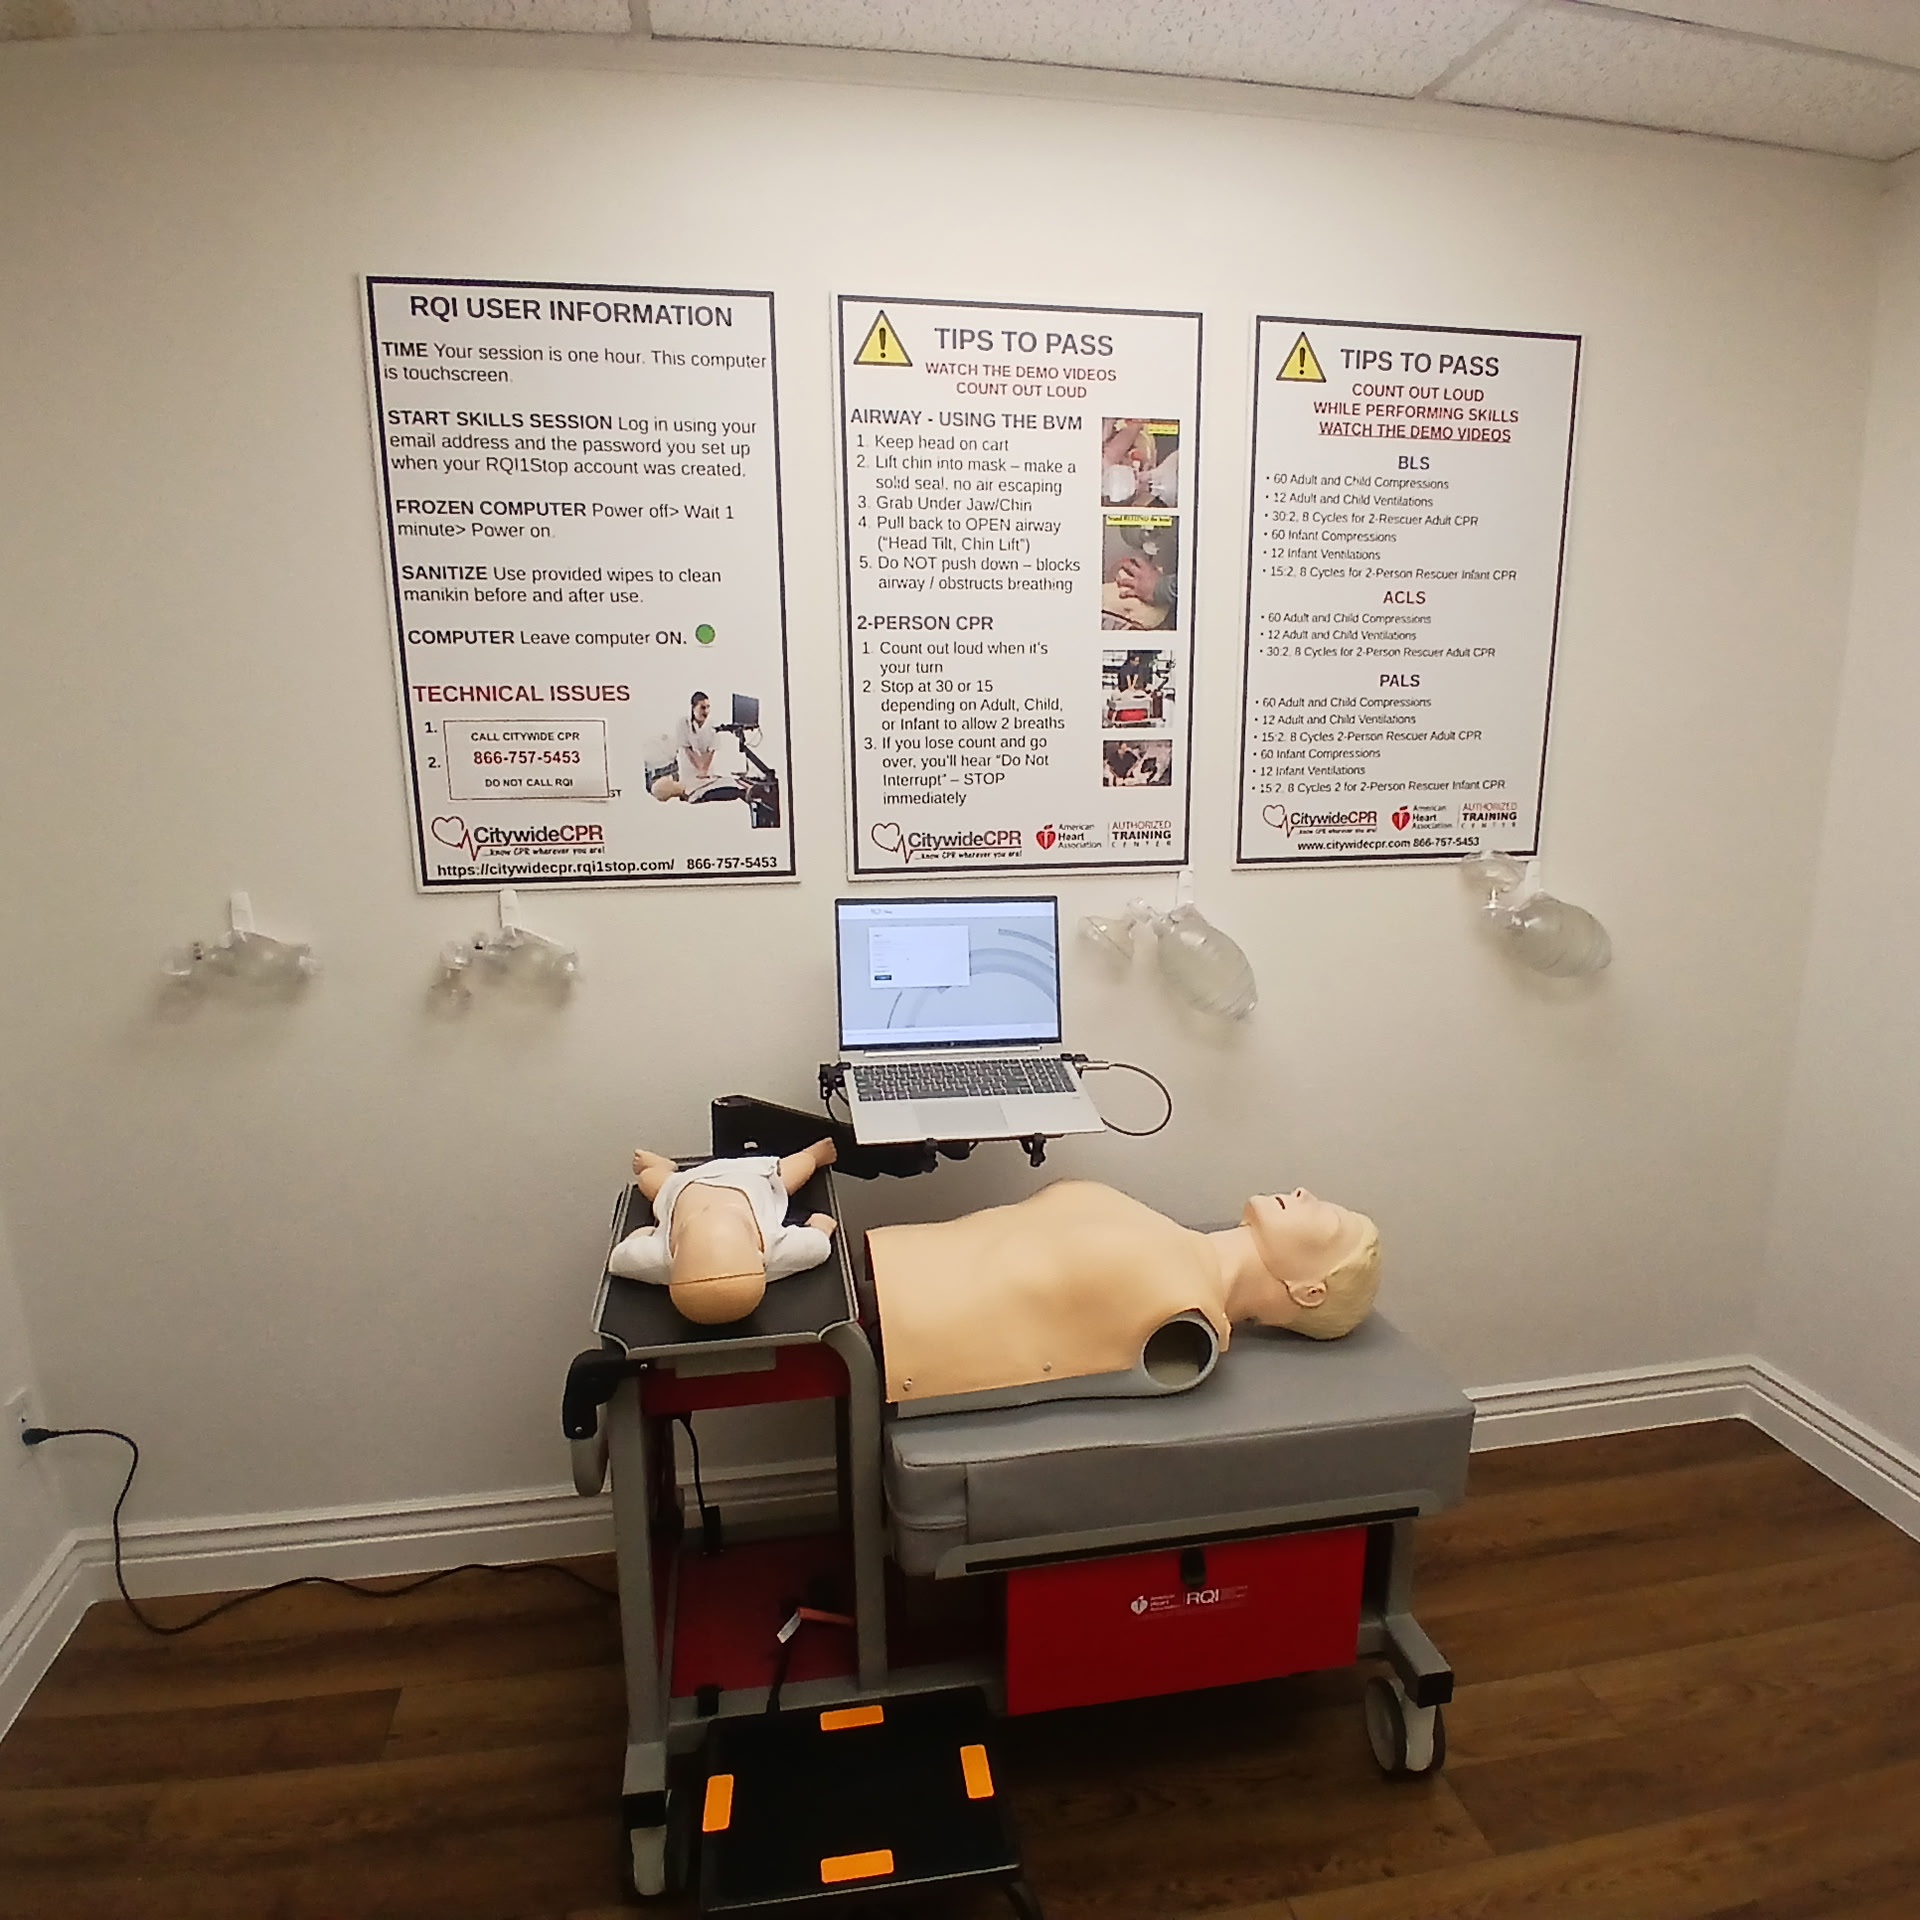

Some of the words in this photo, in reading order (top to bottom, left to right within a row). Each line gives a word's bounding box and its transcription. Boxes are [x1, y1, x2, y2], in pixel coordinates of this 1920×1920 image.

[410, 295, 458, 323] RQI
[466, 297, 542, 320] USER
[549, 300, 733, 327] INFORMATION
[933, 328, 994, 352] TIPS
[1001, 330, 1038, 353] TO
[1046, 333, 1114, 357] PASS
[380, 341, 429, 358] TIME
[433, 342, 473, 359] Your
[478, 345, 544, 361] session
[548, 345, 563, 362] is
[567, 350, 599, 363] one
[650, 349, 686, 366] This
[690, 354, 767, 370] computer
[1340, 348, 1393, 372] TIPS
[1399, 352, 1432, 374] TO
[1439, 354, 1500, 377] PASS
[383, 364, 399, 380] is
[925, 362, 978, 376] WATCH
[982, 364, 1012, 378] THE
[1015, 365, 1059, 380] DEMO
[1062, 367, 1117, 382] VIDEOS
[956, 381, 1008, 395] COUNT
[1012, 383, 1043, 397] OUT
[1046, 385, 1087, 399] LOUD
[1351, 383, 1406, 398] COUNT
[1408, 385, 1441, 400] OUT
[1443, 387, 1485, 402] LOUD
[850, 408, 922, 425] AIRWAY
[939, 411, 996, 428] USING
[1001, 413, 1037, 430] THE
[1042, 414, 1082, 430] BVM
[1313, 401, 1362, 416] WHILE
[1365, 403, 1464, 420] PERFORMING
[1468, 408, 1519, 423] SKILLS
[387, 409, 451, 426] START
[456, 411, 524, 428] SKILLS
[529, 413, 613, 430] SESSION
[618, 416, 649, 435] Log
[654, 416, 669, 432] in
[673, 420, 717, 437] using
[721, 421, 757, 437] your
[1319, 421, 1373, 436] WATCH
[1376, 423, 1406, 437] THE
[1410, 425, 1454, 439] DEMO
[1457, 427, 1512, 442] VIDEOS
[874, 434, 914, 451] Keep
[918, 435, 955, 450] head
[959, 439, 978, 451] on
[981, 439, 1009, 452] cart
[391, 456, 438, 471] when
[442, 458, 481, 475] your
[486, 457, 569, 476] RQI1Stop
[573, 461, 639, 475] account
[643, 463, 677, 476] was
[681, 462, 746, 477] created.
[1398, 455, 1430, 471] BLS
[1273, 473, 1288, 485] 60
[1289, 474, 1318, 486] Adult
[1320, 475, 1342, 487] and
[1343, 475, 1372, 487] Child
[1373, 476, 1450, 490] Compressions
[395, 499, 474, 515] FROZEN
[479, 500, 587, 517] COMPUTER
[591, 502, 644, 518] Power
[649, 503, 680, 519] off>
[683, 504, 720, 520] Wait
[726, 505, 735, 520] 1
[877, 515, 904, 530] Pull
[908, 516, 944, 531] back
[947, 518, 961, 531] to
[965, 517, 1011, 532] OPEN
[1015, 519, 1062, 536] airway
[1301, 511, 1310, 522] 8
[1312, 511, 1349, 526] Cycles
[1351, 512, 1366, 524] for
[1368, 513, 1423, 525] 2-Rescuer
[1424, 514, 1452, 526] Adult
[1454, 515, 1479, 527] CPR
[397, 522, 466, 537] minute>
[471, 522, 526, 538] Power
[401, 565, 489, 581] SANITIZE
[493, 566, 527, 581] Use
[532, 567, 603, 584] provided
[606, 567, 654, 584] wipes
[658, 569, 674, 583] to
[678, 568, 722, 583] clean
[1382, 590, 1426, 605] ACLS
[857, 615, 950, 631] 2-PERSON
[955, 615, 994, 631] CPR
[407, 629, 515, 645] COMPUTER
[520, 630, 570, 645] Leave
[574, 632, 651, 648] computer
[655, 630, 687, 645] ON.
[879, 641, 923, 655] Count
[926, 642, 950, 655] out
[953, 641, 984, 655] loud
[987, 641, 1025, 655] when
[880, 679, 914, 695] Stop
[917, 681, 932, 693] at
[935, 679, 954, 693] 30
[957, 682, 972, 693] or
[976, 679, 994, 693] 15
[1379, 674, 1420, 688] PALS
[412, 685, 545, 703] TECHNICAL
[549, 685, 631, 702] ISSUES
[424, 721, 438, 734] 1.
[470, 731, 501, 742] CALL
[502, 731, 555, 742] CITYWIDE
[556, 731, 580, 741] CPR
[882, 736, 891, 750] If
[894, 738, 921, 753] you
[924, 736, 954, 749] lose
[958, 737, 996, 749] count
[1000, 735, 1026, 749] and
[1029, 737, 1048, 751] go
[427, 756, 441, 769] 2.
[473, 750, 581, 765] 866-757-5453
[1260, 765, 1273, 777] 12
[1275, 765, 1305, 777] Infant
[1307, 765, 1366, 776] Ventilations
[484, 778, 501, 788] DO
[502, 778, 523, 787] NOT
[526, 778, 554, 787] CALL
[555, 777, 574, 787] RQI
[1290, 811, 1378, 826] CitywideCPR
[1412, 813, 1437, 822] Heart
[1462, 812, 1518, 824] TRAINING
[473, 825, 605, 844] CitywideCPR
[907, 830, 1023, 847] CitywideCPR
[1057, 832, 1085, 841] Heart
[1111, 831, 1172, 841] TRAINING
[1297, 839, 1411, 851] www.citywidecpr.com
[1412, 836, 1480, 848] 866-757-5453
[436, 859, 675, 877] https://citywidecpr.rqi1stop.com/
[686, 856, 778, 870] 866-757-5453
[1186, 1589, 1220, 1605] RQI
